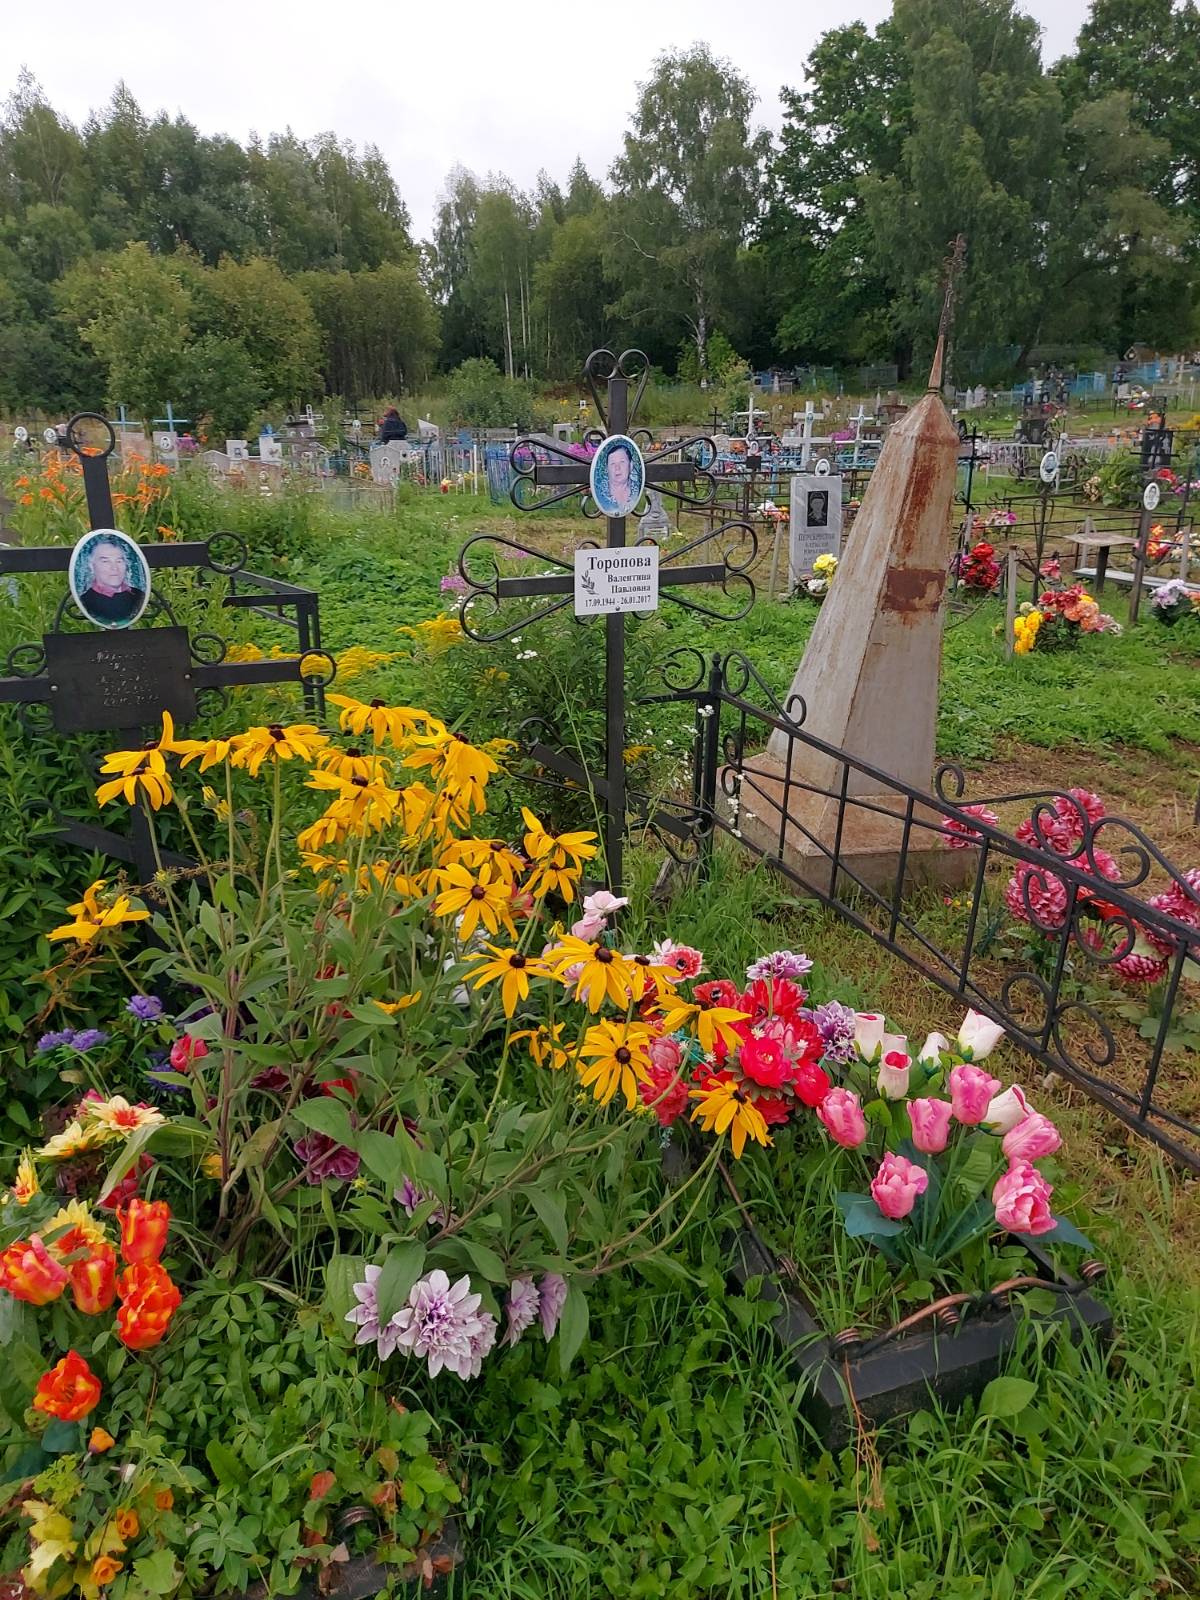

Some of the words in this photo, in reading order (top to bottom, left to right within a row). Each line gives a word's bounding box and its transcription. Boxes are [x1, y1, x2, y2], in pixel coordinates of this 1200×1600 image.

[588, 556, 651, 572] Торопова
[608, 574, 651, 583] Валентина
[612, 585, 650, 593] Павловна
[586, 598, 615, 607] 17.09.1944
[621, 595, 651, 604] 26.01.2017
